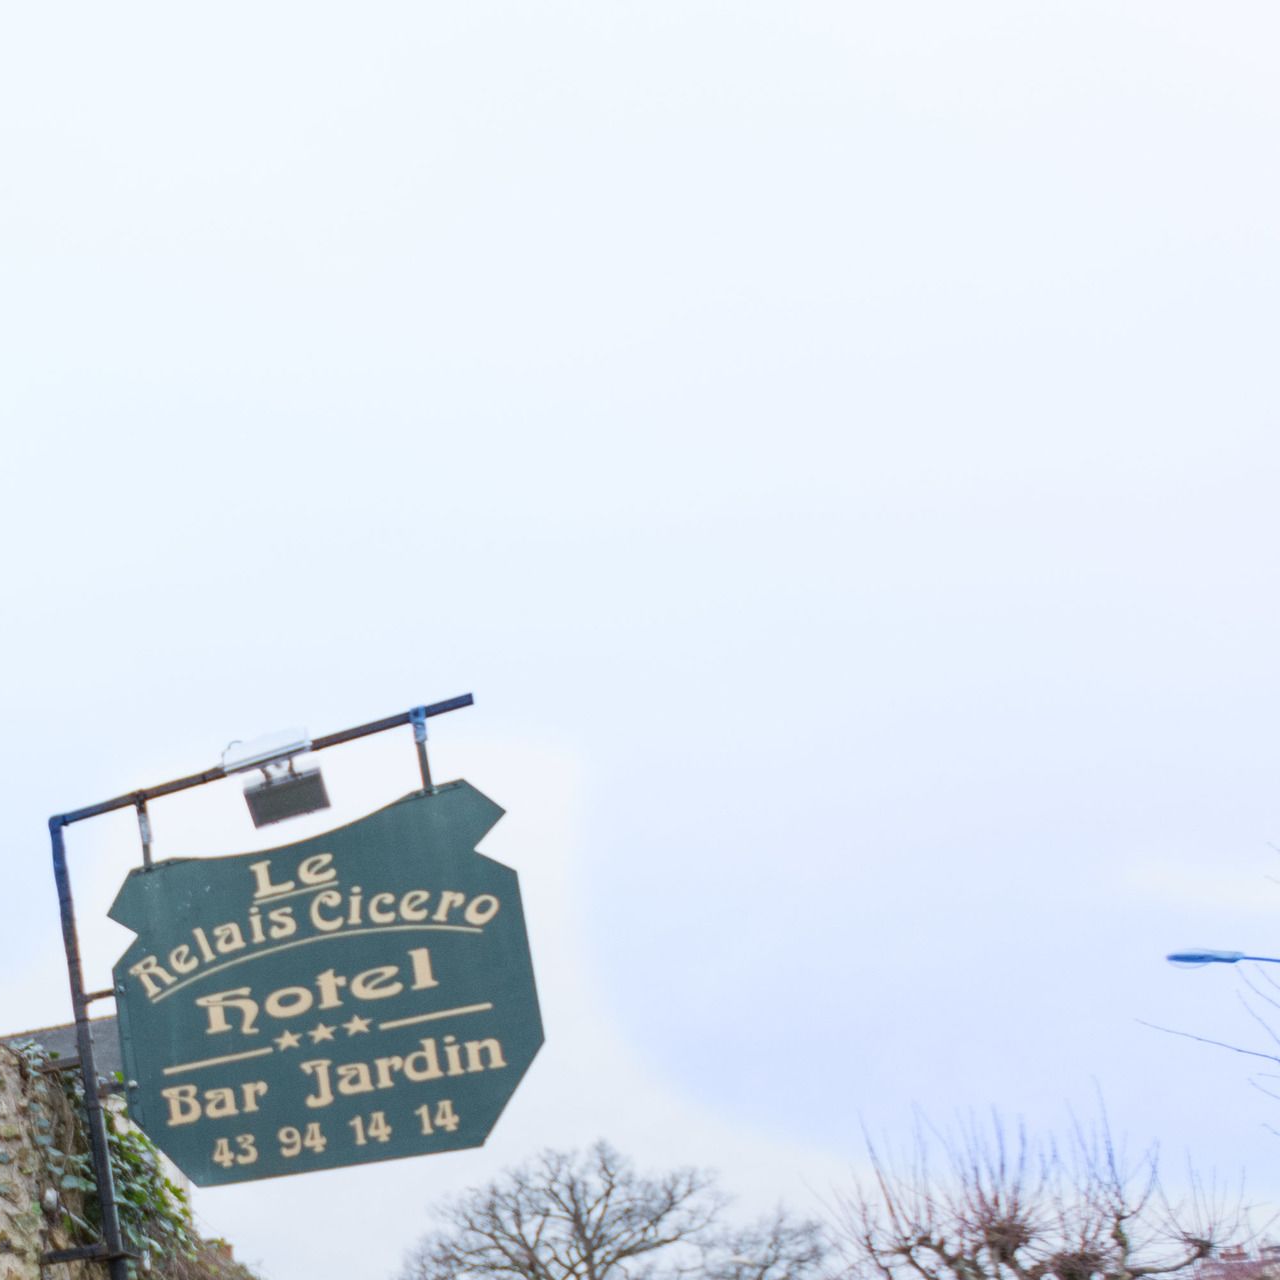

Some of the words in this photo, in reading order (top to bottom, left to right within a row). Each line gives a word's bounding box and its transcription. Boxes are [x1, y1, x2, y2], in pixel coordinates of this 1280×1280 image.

[249, 853, 337, 898] Le
[129, 905, 297, 998] Relais
[309, 886, 500, 932] Cicero
[161, 1080, 268, 1127] Bar
[299, 1035, 508, 1108] Jardin
[212, 1133, 258, 1168] 43
[278, 1122, 327, 1158] 94
[349, 1111, 392, 1146] 14
[415, 1100, 460, 1136] 14
